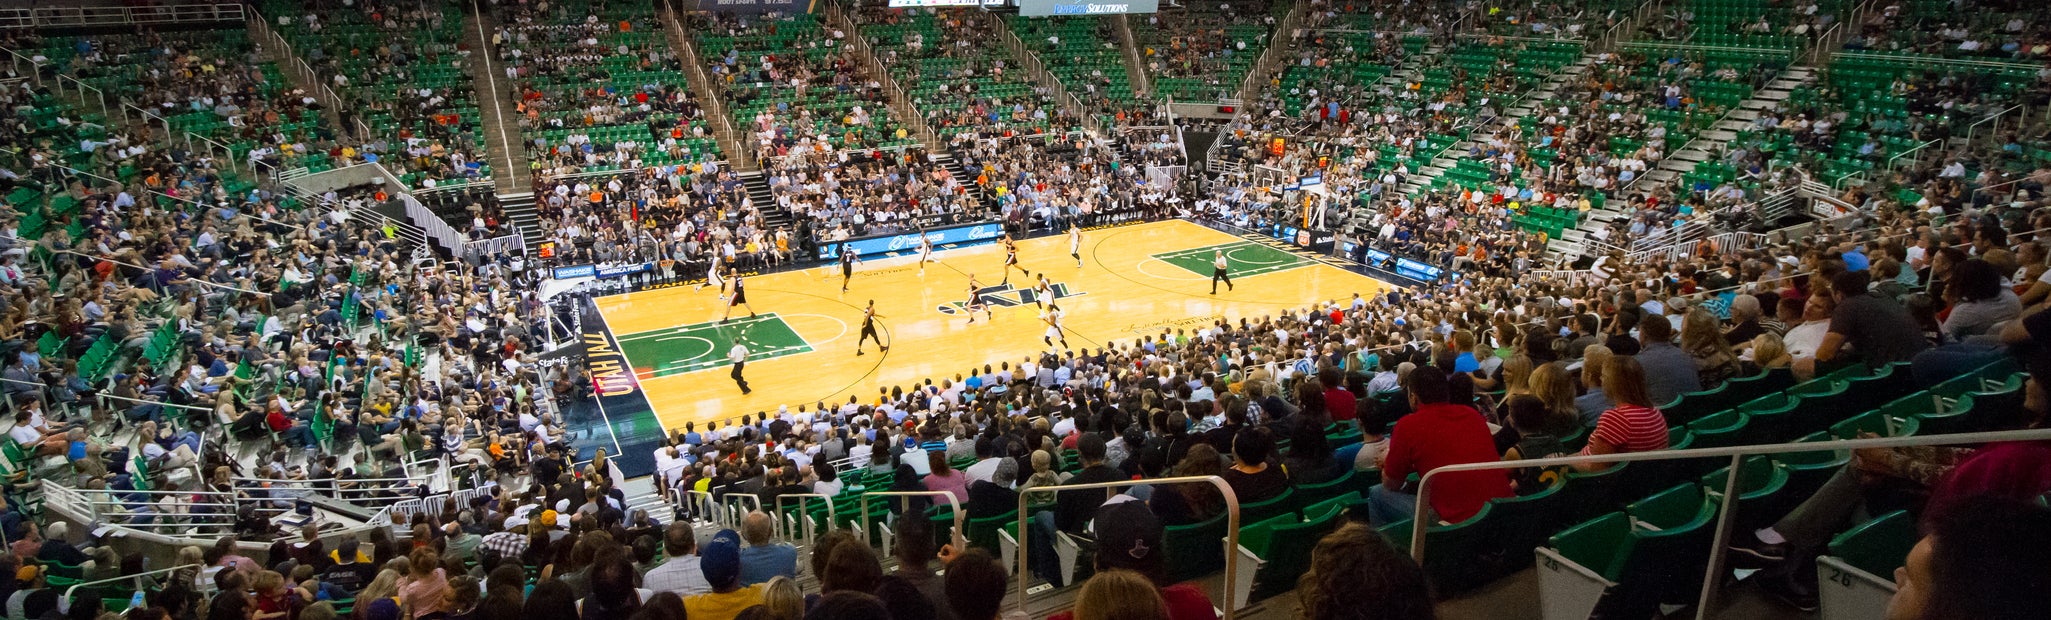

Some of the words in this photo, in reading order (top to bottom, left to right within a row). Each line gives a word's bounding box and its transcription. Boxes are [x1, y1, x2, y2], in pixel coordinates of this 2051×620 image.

[600, 267, 627, 275] AMERICA
[627, 265, 645, 273] FIRST
[584, 331, 621, 357] JAZZ
[590, 360, 633, 397] UTAH
[1830, 569, 1852, 587] 26
